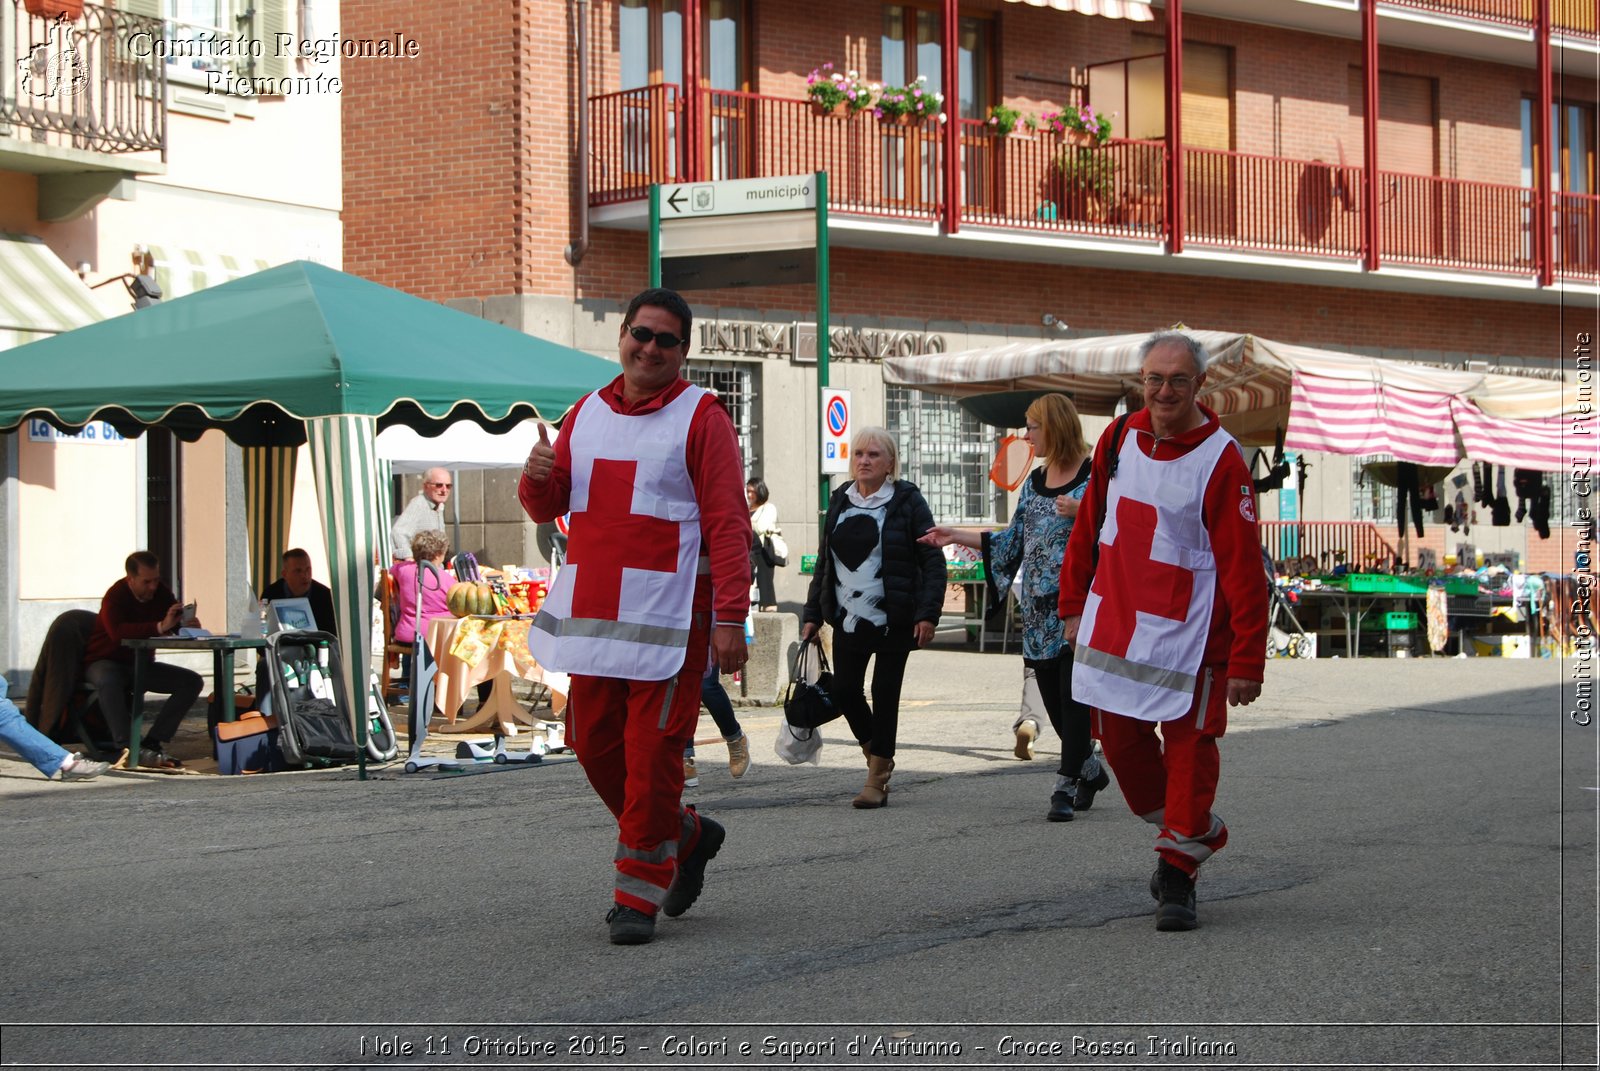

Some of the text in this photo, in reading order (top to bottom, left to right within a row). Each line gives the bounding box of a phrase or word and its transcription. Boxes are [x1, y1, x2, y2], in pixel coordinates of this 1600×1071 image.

[746, 184, 810, 200] municipio
[699, 321, 792, 353] INTESA
[31, 417, 49, 437] La
